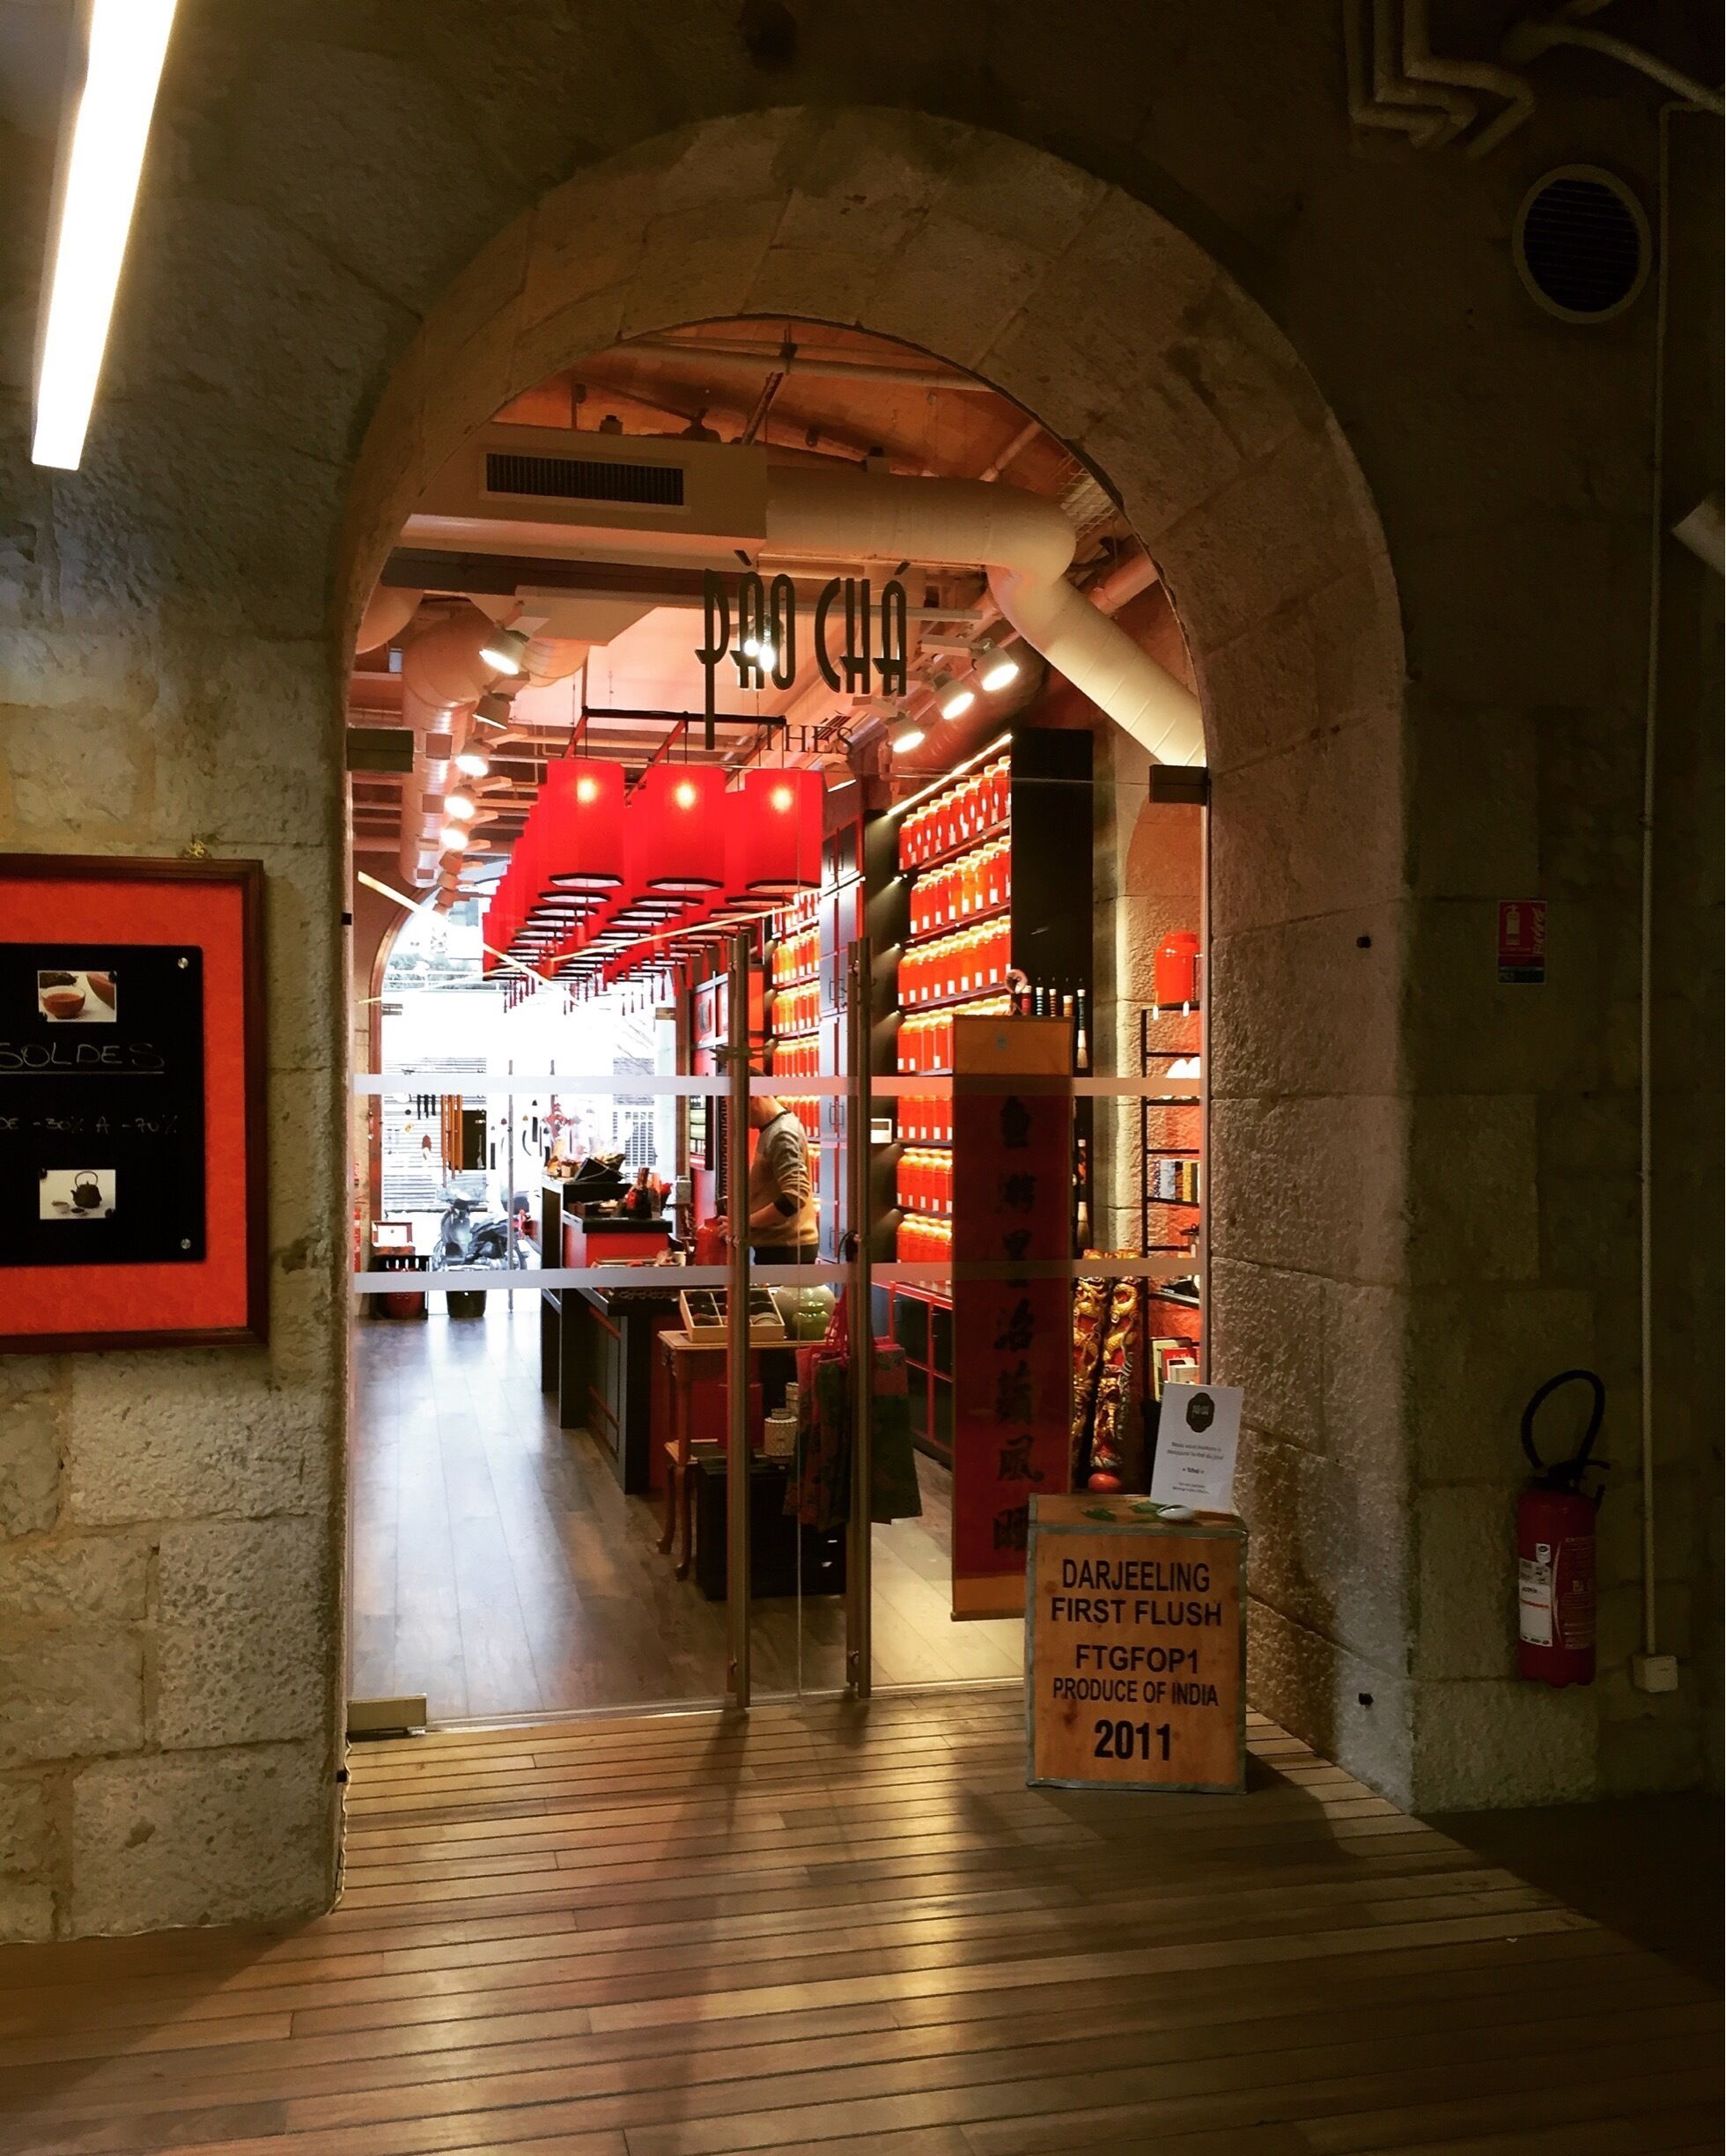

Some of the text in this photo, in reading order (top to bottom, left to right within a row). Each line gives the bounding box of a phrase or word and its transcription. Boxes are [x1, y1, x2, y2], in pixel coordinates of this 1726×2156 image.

[815, 562, 910, 697] CHÁ
[0, 1042, 166, 1069] SOLDES
[1062, 1558, 1210, 1593] DARJEELING
[1051, 1597, 1221, 1627] FIRST FLUSH
[1075, 1643, 1199, 1674] FTGFOP1
[1053, 1677, 1219, 1707] PRODUCE OF INDIA
[1094, 1719, 1170, 1761] 2011
